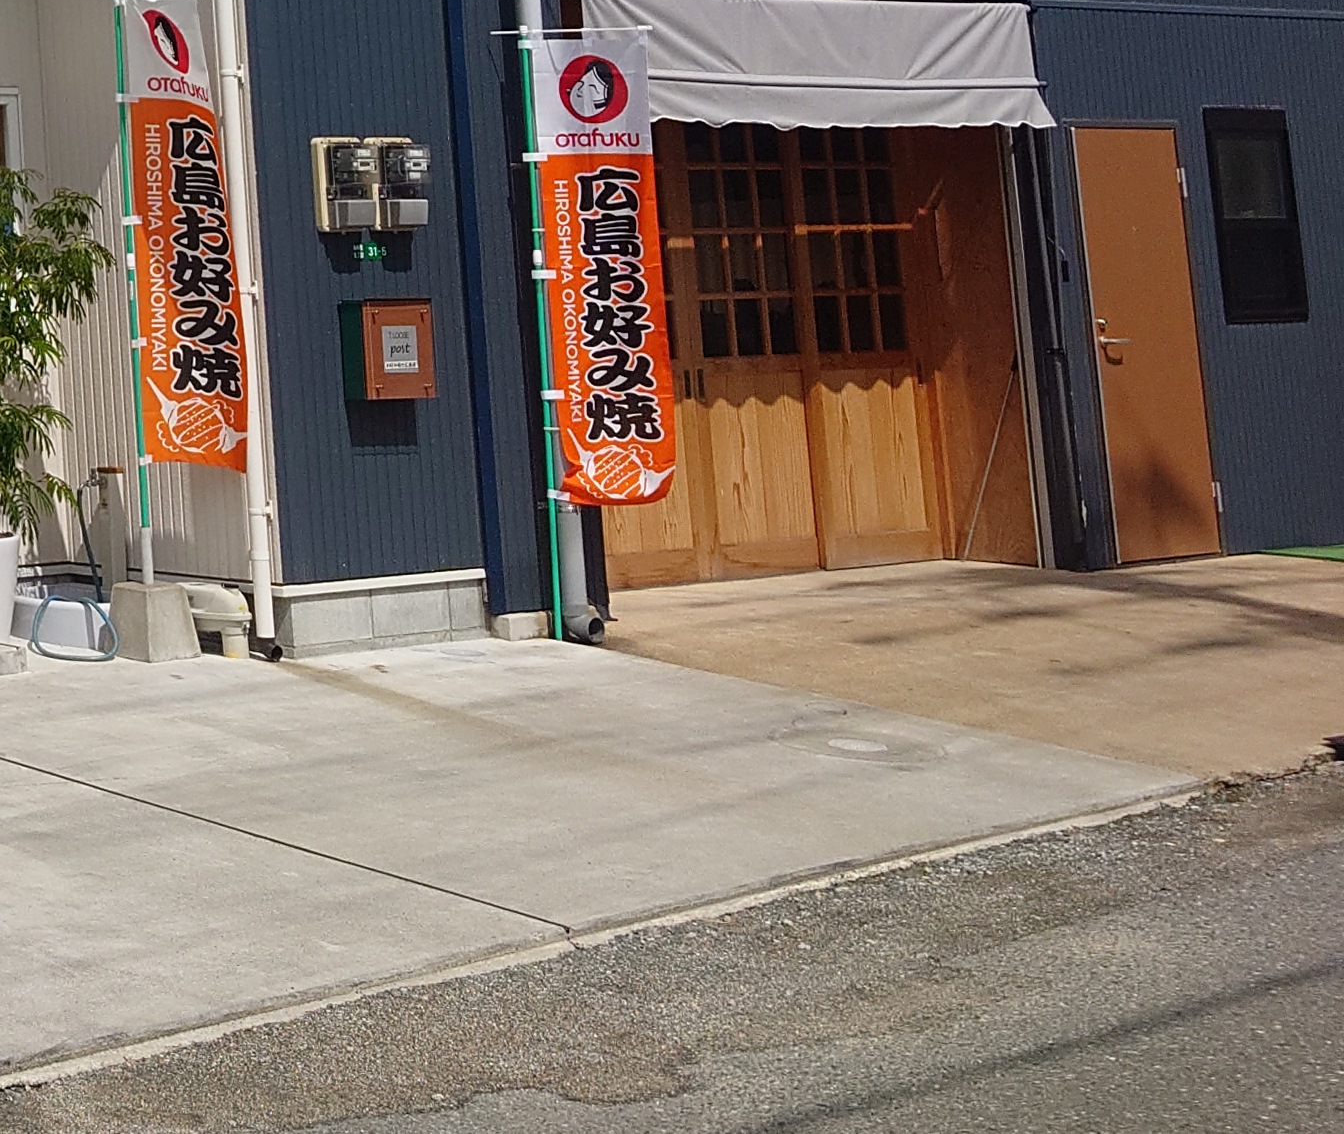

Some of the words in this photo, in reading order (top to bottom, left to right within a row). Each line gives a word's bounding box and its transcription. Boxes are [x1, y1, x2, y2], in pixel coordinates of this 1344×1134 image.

[144, 123, 164, 231] HIROSHIMA
[553, 179, 575, 284] HIROSHIMA
[147, 235, 168, 372] OKONOMIYAKI
[167, 116, 243, 401] 広島お好み焼
[575, 165, 664, 443] 広島お好み焼
[390, 342, 411, 358] post
[562, 287, 583, 423] OKONOMIYAKI
